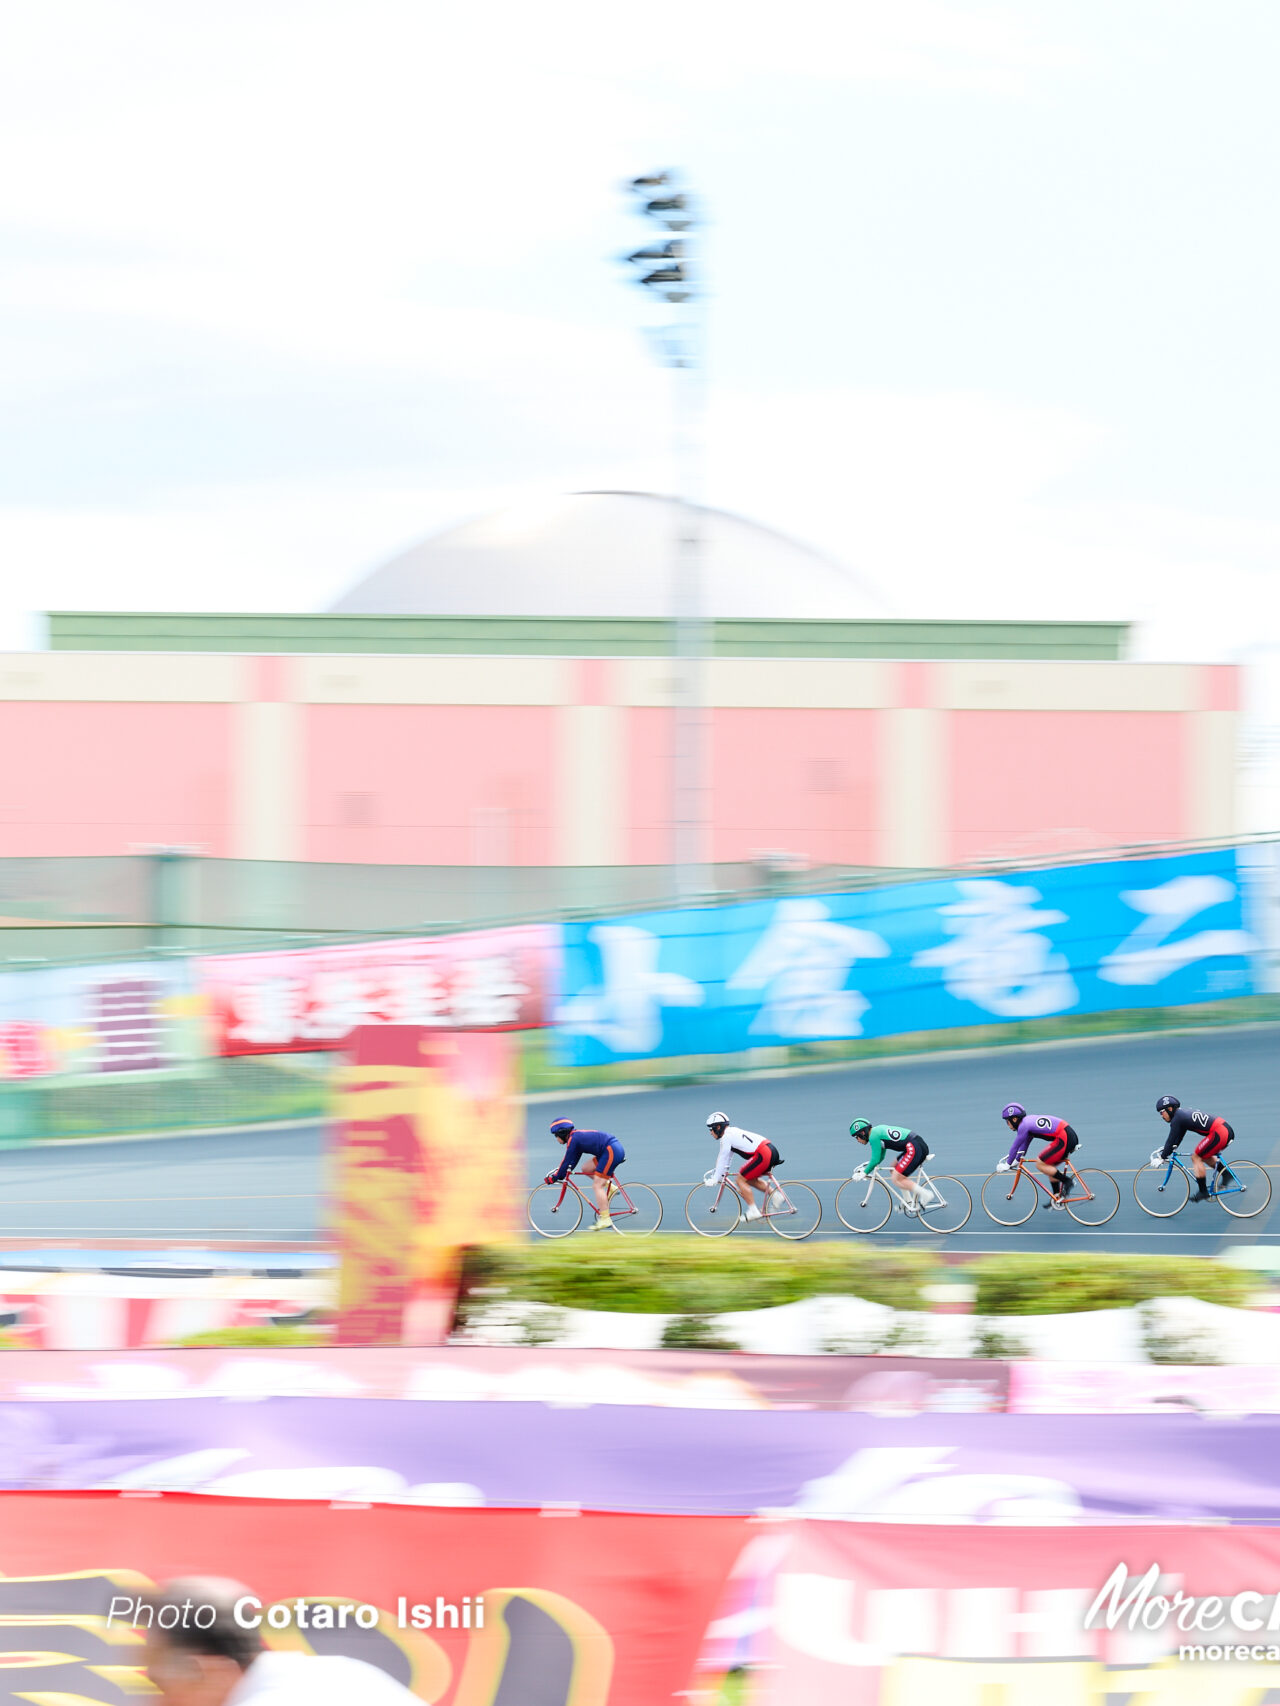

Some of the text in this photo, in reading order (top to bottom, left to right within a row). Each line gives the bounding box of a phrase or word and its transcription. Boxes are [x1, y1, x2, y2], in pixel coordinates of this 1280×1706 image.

[1036, 1117, 1052, 1130] 9
[1191, 1111, 1209, 1127] 2
[742, 1133, 754, 1143] 1
[886, 1128, 901, 1142] 6
